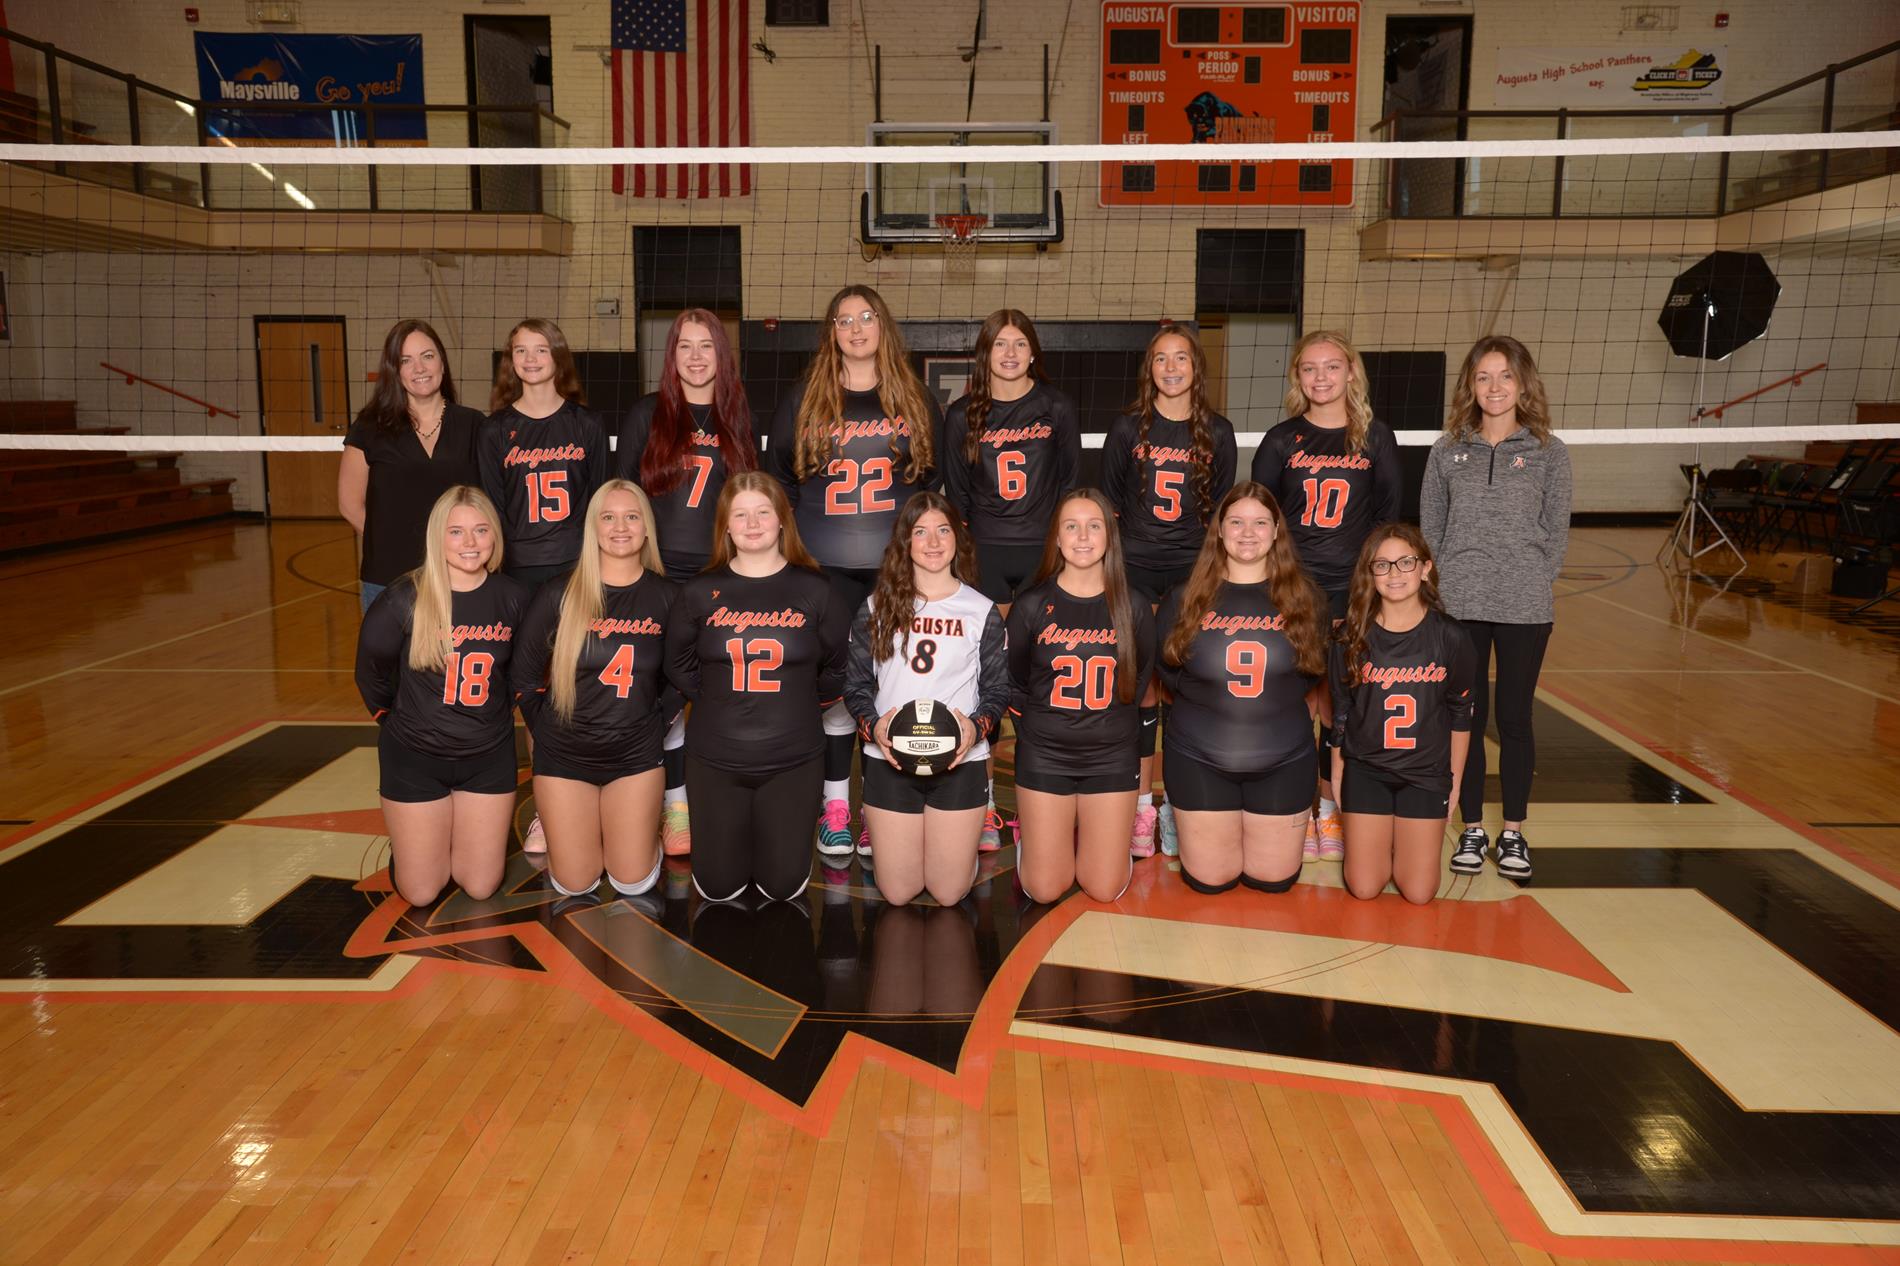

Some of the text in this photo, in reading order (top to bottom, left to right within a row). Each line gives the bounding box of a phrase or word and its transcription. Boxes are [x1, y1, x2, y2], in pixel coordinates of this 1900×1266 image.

[1106, 7, 1165, 23] AUGUSTA
[1297, 7, 1356, 22] VISITOR
[1198, 62, 1239, 74] PERIOD
[1207, 51, 1230, 61] POSS
[315, 61, 405, 104] Go you!
[1129, 70, 1167, 82] BONUS
[1292, 70, 1331, 82] BONUS
[1497, 54, 1653, 88] Augusta High School Panthers
[219, 80, 301, 101] Maysville
[1109, 91, 1165, 103] TIMEOUTS
[1294, 91, 1350, 103] TIMEOUTS
[1122, 133, 1149, 144] LEFT
[1307, 133, 1334, 143] LEFT
[979, 422, 1053, 449] ugusta
[504, 443, 586, 470] Augusta
[1285, 449, 1372, 475] Augusta
[683, 455, 714, 508] 7
[824, 457, 896, 516] 22
[996, 450, 1027, 501] 6
[525, 470, 571, 523] 15
[1153, 470, 1185, 522] 5
[1301, 478, 1351, 529] 10
[586, 616, 663, 639] ugusta
[706, 606, 807, 634] Augusta
[902, 617, 964, 637] GUSTA
[1200, 611, 1287, 636] August
[446, 621, 513, 647] gusta
[1037, 622, 1119, 651] August
[726, 637, 784, 693] 12
[911, 639, 938, 674] 8
[1225, 640, 1268, 698] 9
[442, 651, 495, 707] 18
[598, 644, 635, 699] 4
[1050, 655, 1117, 710] 20
[1360, 661, 1448, 690] Augusta
[1384, 694, 1417, 749] 2
[908, 741, 940, 749] TACHIKARA
